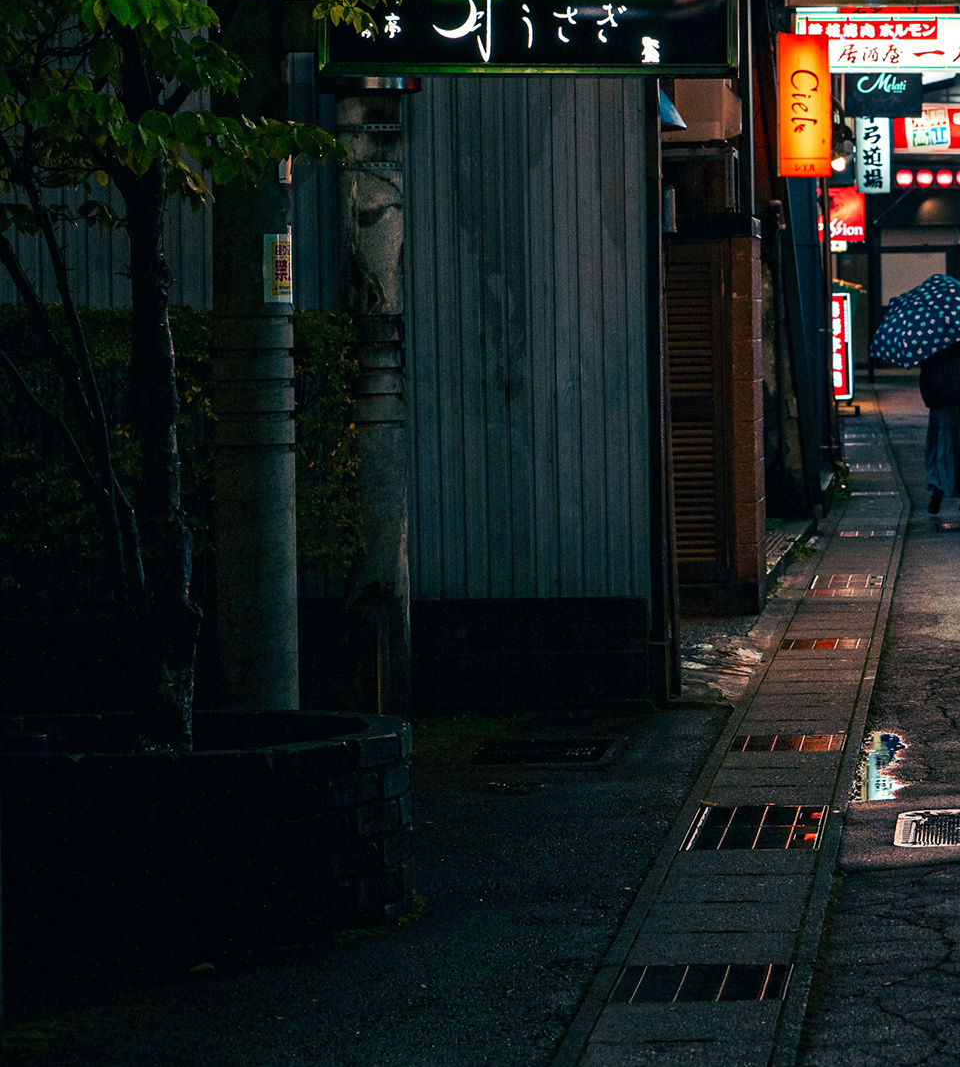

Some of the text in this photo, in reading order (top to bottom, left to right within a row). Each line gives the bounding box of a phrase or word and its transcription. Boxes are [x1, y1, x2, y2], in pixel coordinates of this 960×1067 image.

[838, 44, 903, 64] 居酒屋
[856, 72, 908, 94] Melati
[863, 116, 884, 190] 弓道場
